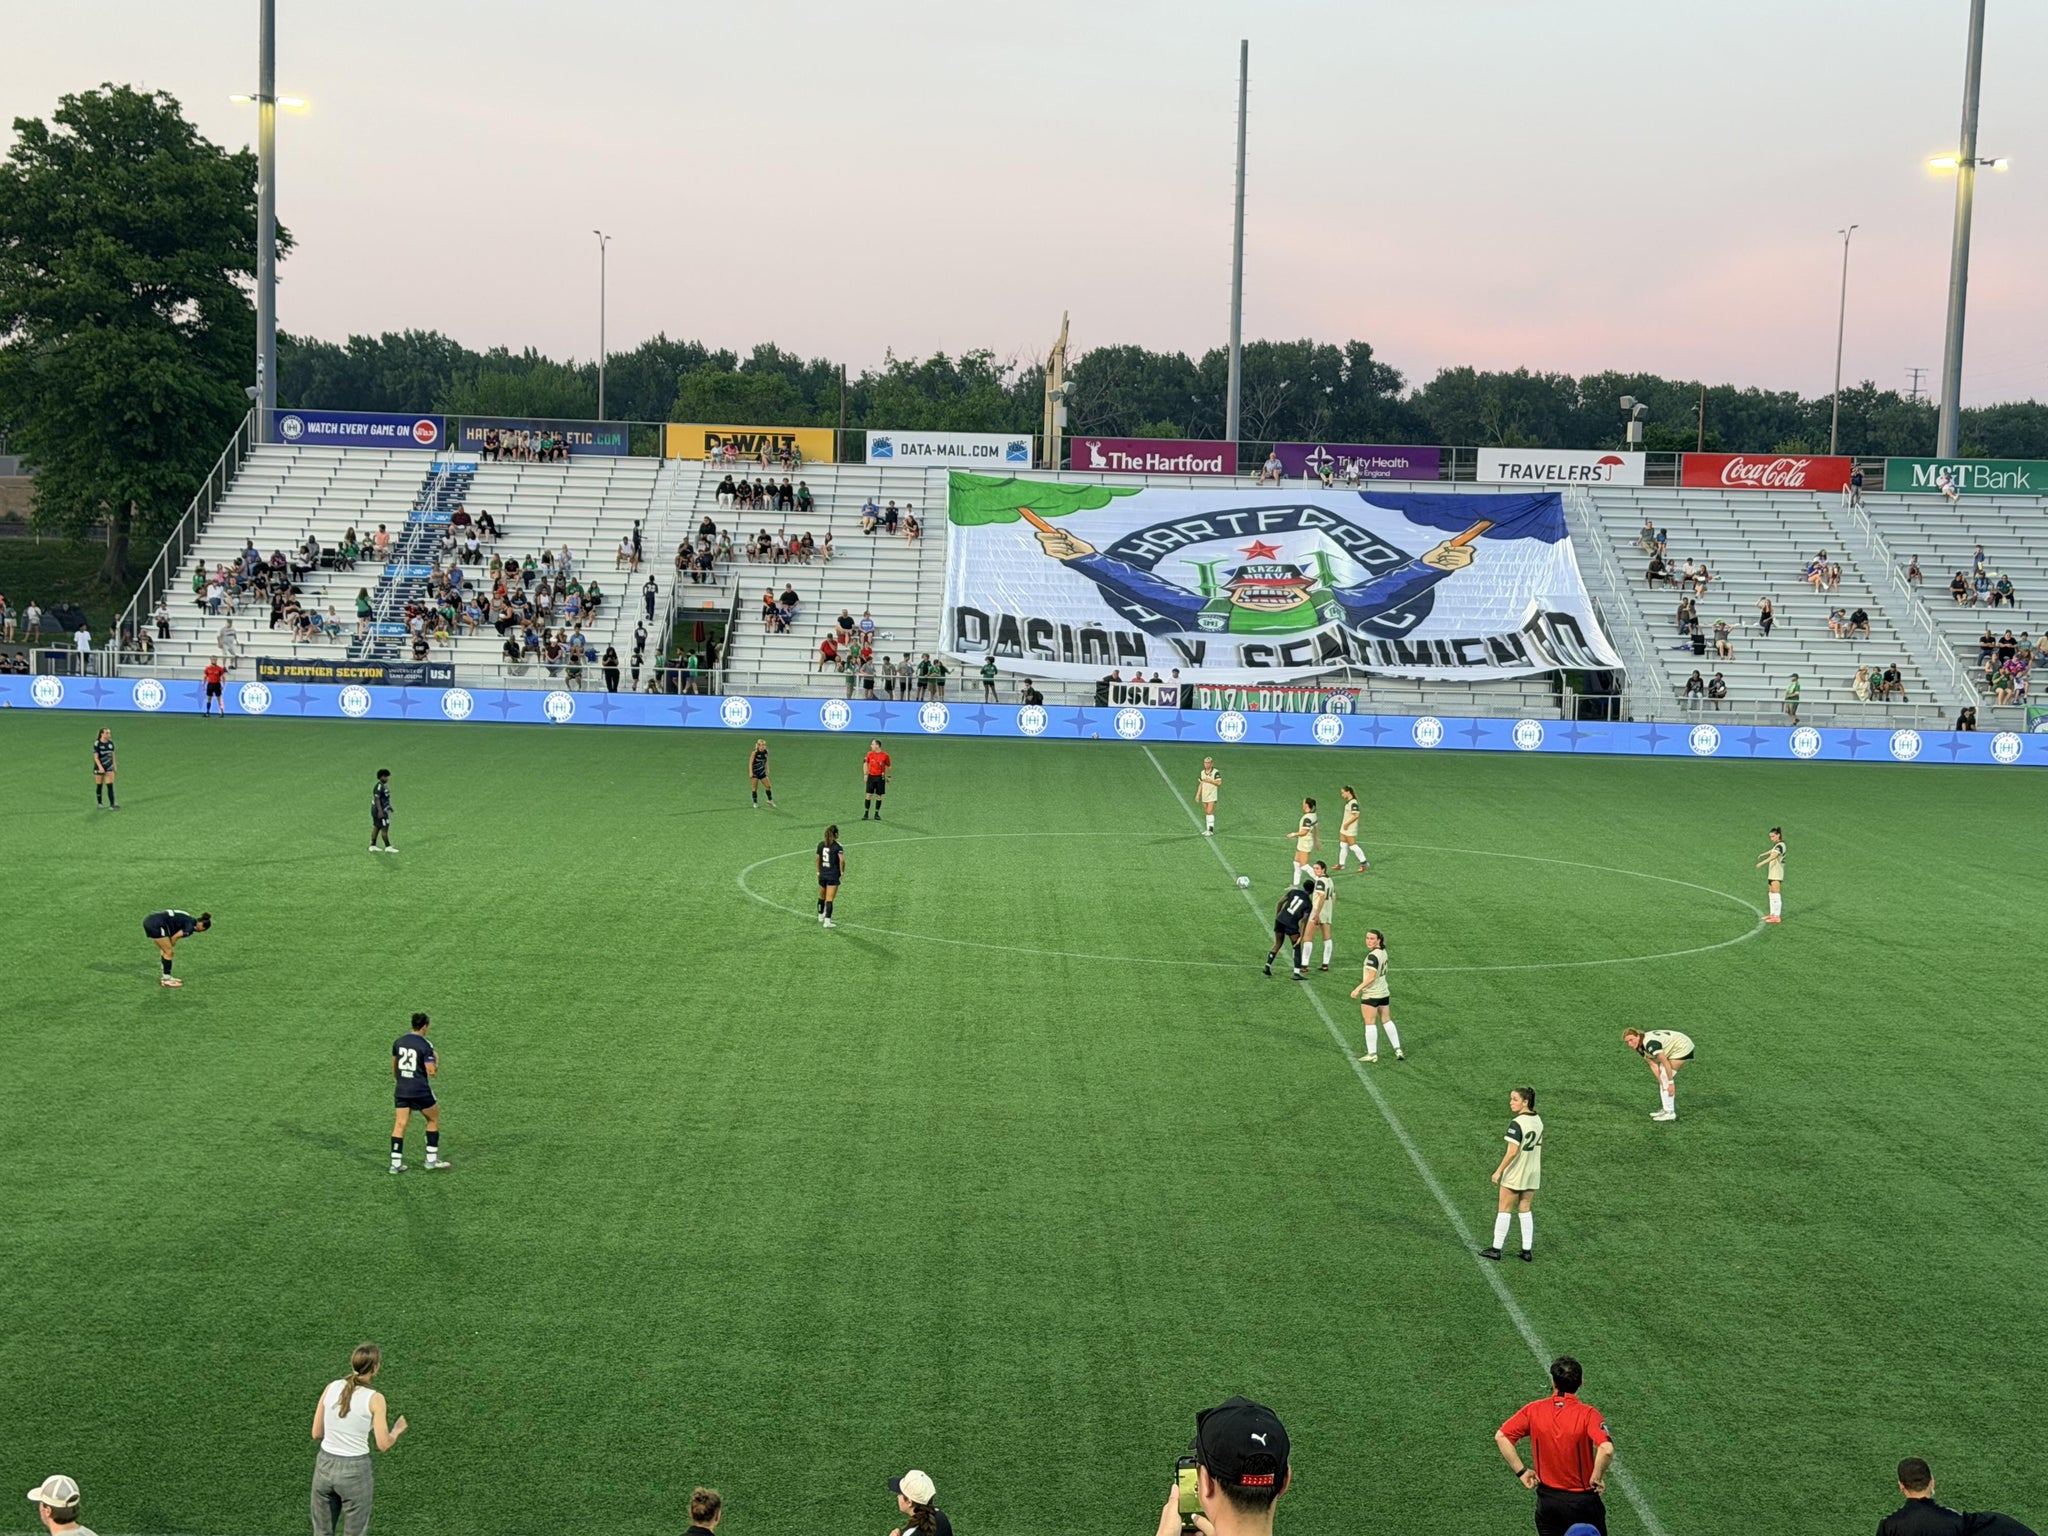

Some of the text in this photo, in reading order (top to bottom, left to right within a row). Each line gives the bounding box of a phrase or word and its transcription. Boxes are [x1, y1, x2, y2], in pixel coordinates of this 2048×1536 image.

[307, 422, 338, 434] WATCH
[340, 423, 367, 435] EVERY
[370, 424, 395, 436] GAME
[396, 425, 410, 437] ON
[901, 443, 999, 458] DATA-MAIL.COM
[1108, 452, 1222, 472] The Hartford
[1337, 455, 1409, 469] Triity Health
[1364, 469, 1390, 478] England
[1498, 463, 1602, 481] TRAVELERS
[1721, 456, 1812, 488] Coca-Cola
[1911, 463, 2030, 489] M&T Bank
[1118, 508, 1400, 565] HARTFORD
[259, 665, 383, 678] USJ FEATHER SECTION
[430, 669, 452, 680] USJ
[822, 847, 830, 862] 5
[398, 1046, 417, 1071] 23
